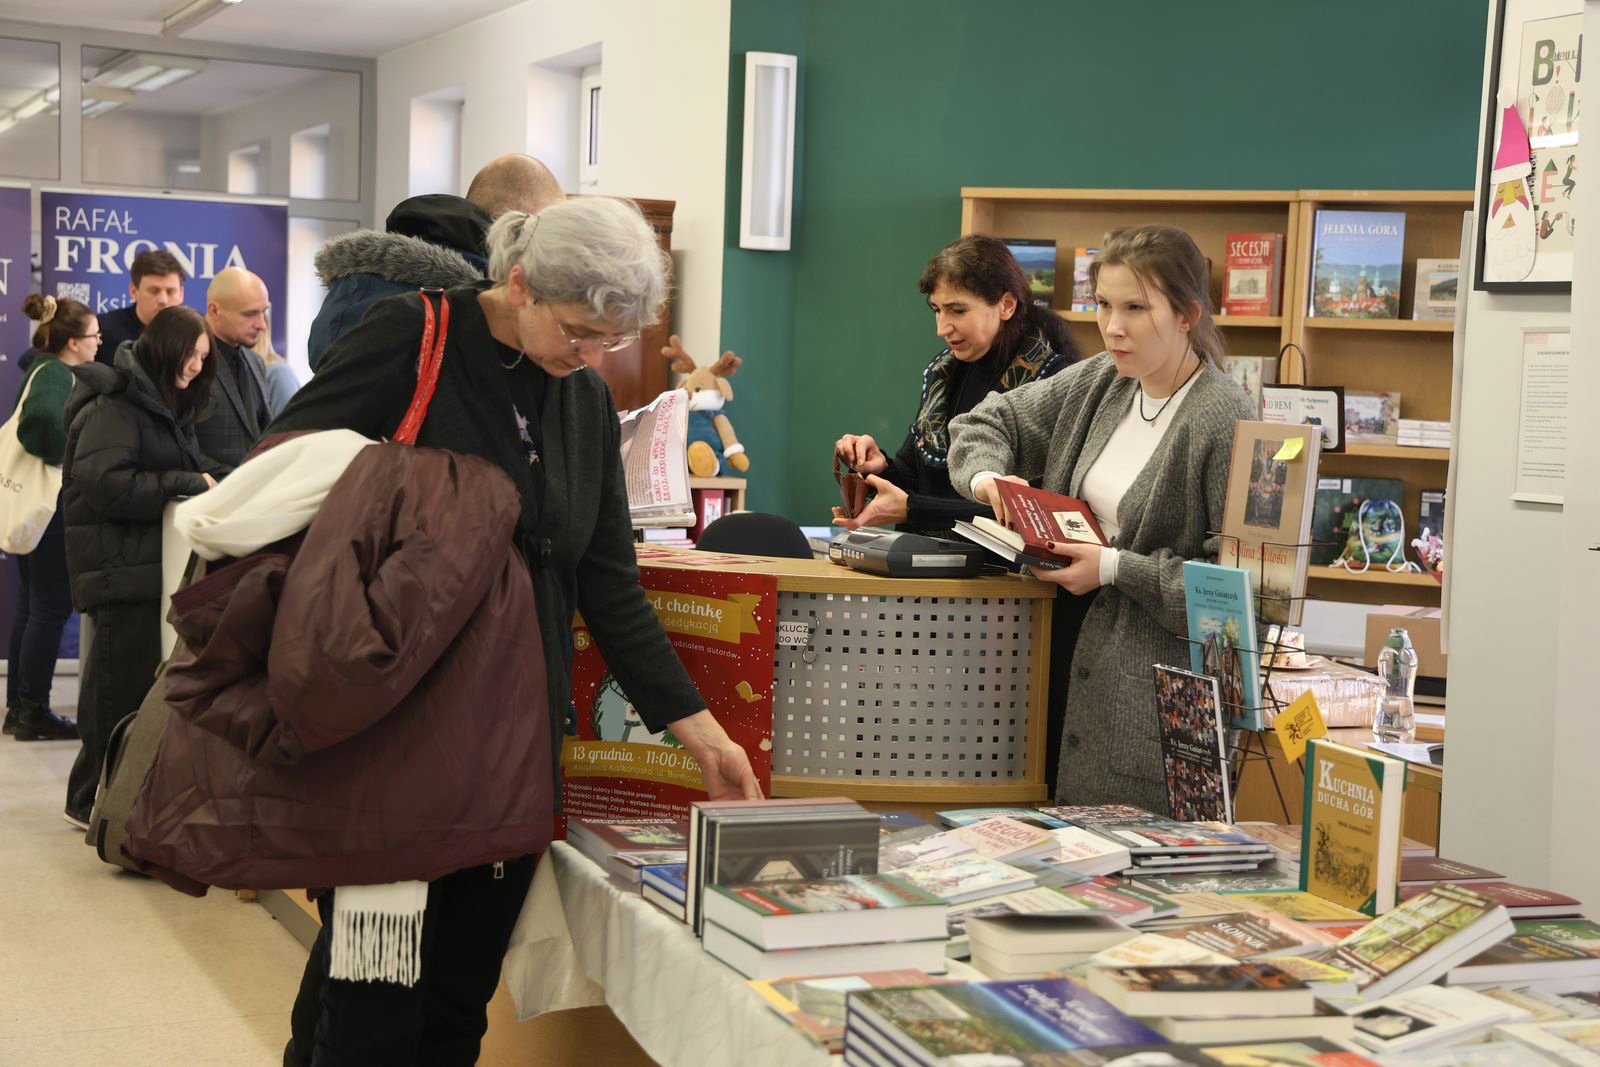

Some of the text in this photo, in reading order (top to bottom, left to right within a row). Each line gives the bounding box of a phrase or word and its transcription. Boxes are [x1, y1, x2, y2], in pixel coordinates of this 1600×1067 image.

[55, 206, 138, 234] RAFAŁ
[1322, 221, 1398, 237] JELENIA GÓRA
[54, 235, 248, 280] FRONIA
[1230, 240, 1270, 257] SECESJA
[97, 290, 136, 314] ksi
[1274, 399, 1292, 410] REM
[1229, 539, 1255, 560] Dlina
[666, 597, 724, 623] choinkę
[664, 617, 719, 633] dedykacją
[779, 624, 808, 633] KLUCZ
[577, 631, 590, 647] 5.
[673, 640, 737, 659] udziałem autorów
[779, 635, 808, 644] DO WC
[572, 746, 702, 774] 13 grudnia 11:00-16:
[1318, 759, 1375, 805] KUCHNIA
[1317, 791, 1374, 820] DUCHA GÓR
[982, 819, 1042, 844] REGION
[1212, 921, 1269, 950] SŁOWNIK
